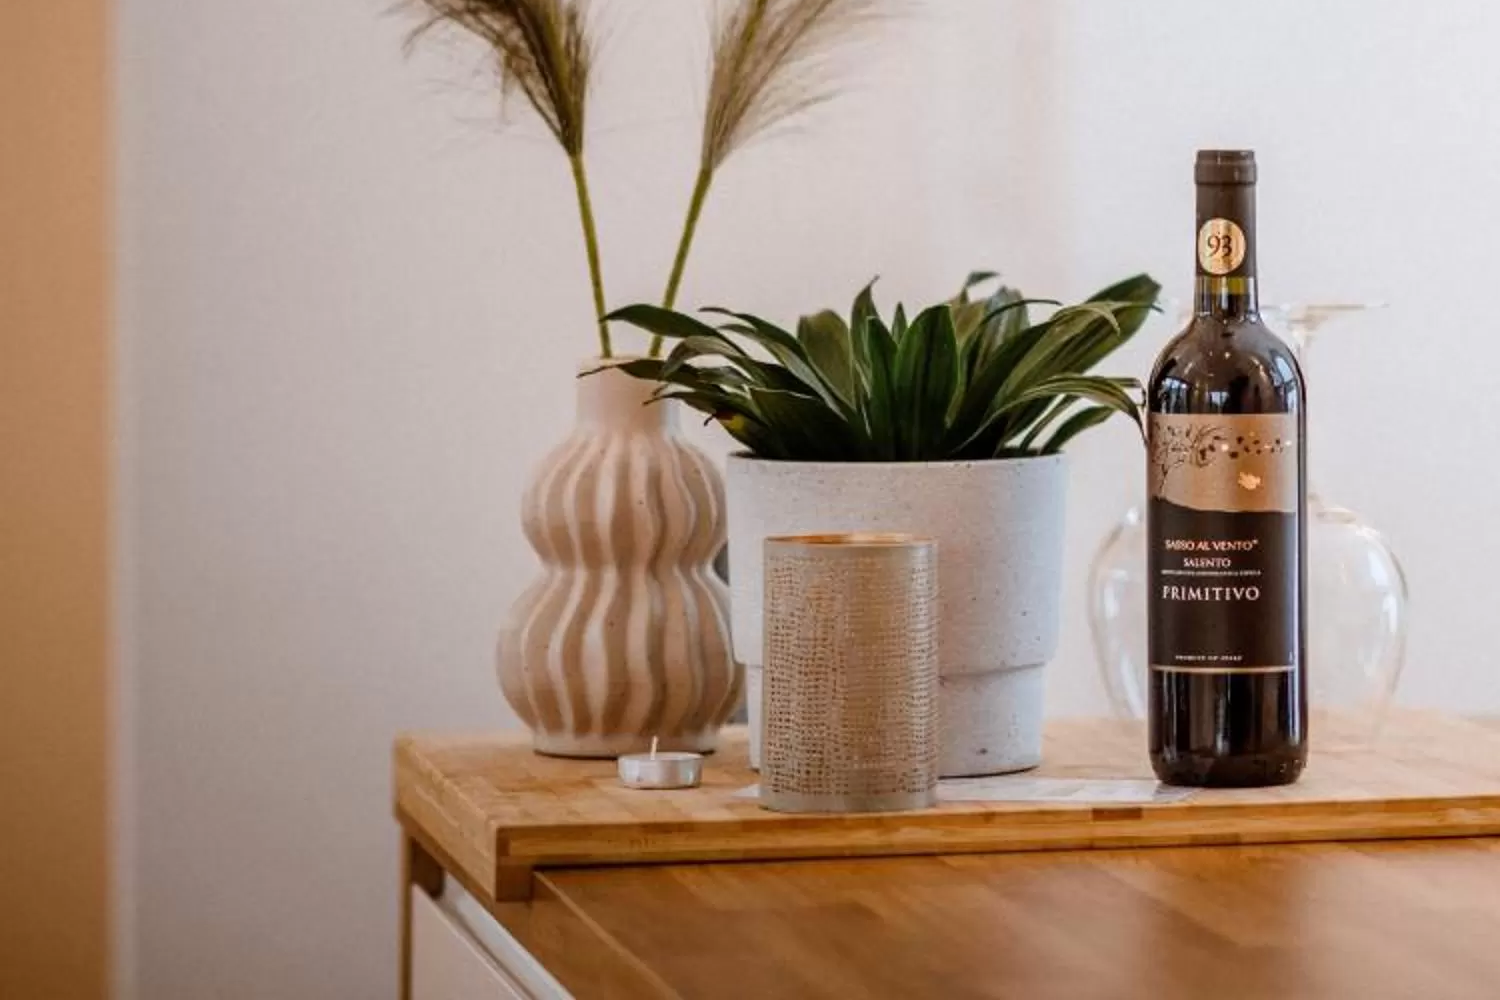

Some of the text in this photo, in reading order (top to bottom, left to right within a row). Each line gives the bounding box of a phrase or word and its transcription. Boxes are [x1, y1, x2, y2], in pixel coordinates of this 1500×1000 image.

[1207, 235, 1233, 257] 93
[1196, 540, 1211, 551] AL
[1183, 557, 1232, 568] SALENTO
[1162, 585, 1260, 601] PRIMITIVO
